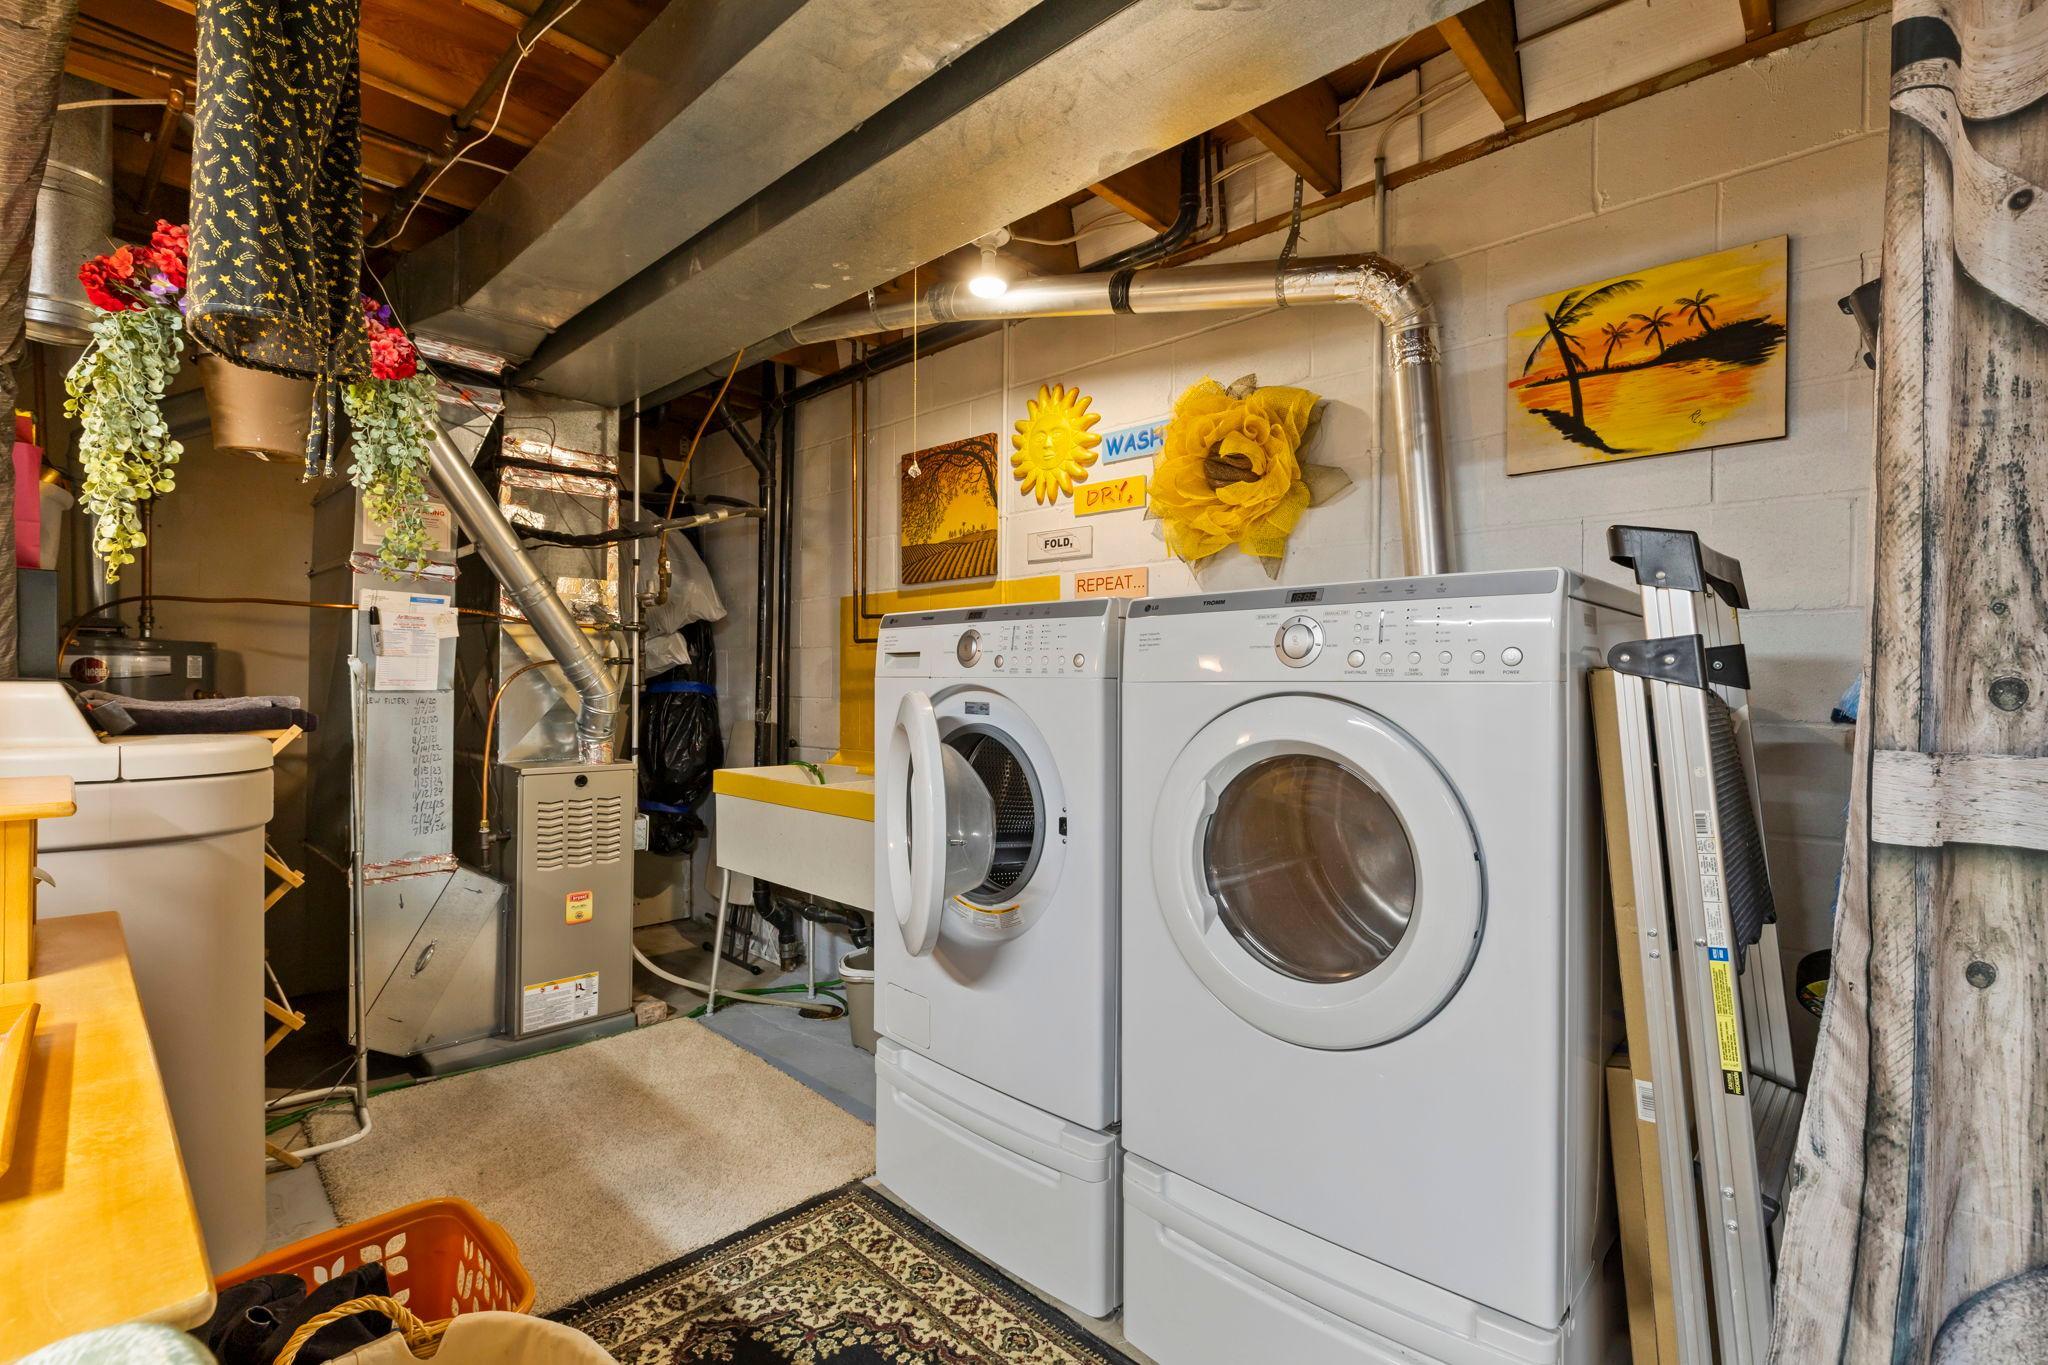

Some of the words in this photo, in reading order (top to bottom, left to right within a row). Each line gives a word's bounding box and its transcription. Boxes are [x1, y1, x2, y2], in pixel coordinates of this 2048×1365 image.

[1044, 537, 1073, 549] FOLD,
[1077, 574, 1145, 593] REPEAT...
[366, 696, 380, 705] EW
